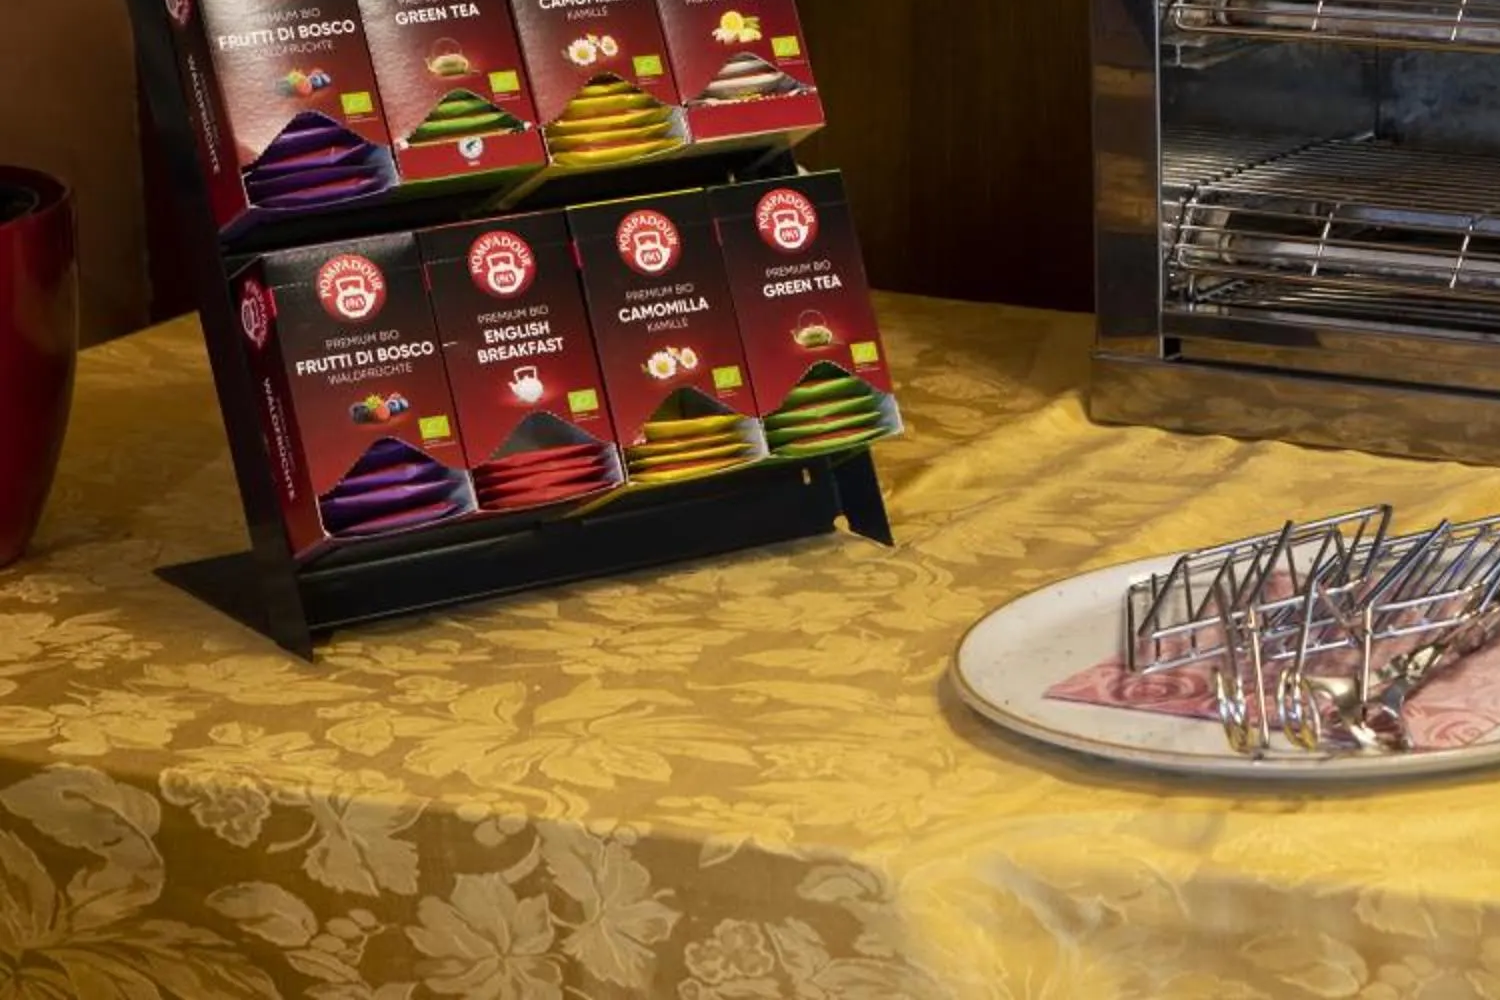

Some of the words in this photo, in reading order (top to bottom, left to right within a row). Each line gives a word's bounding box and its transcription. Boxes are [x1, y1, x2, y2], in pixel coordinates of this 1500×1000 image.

[395, 6, 447, 25] GREEN
[449, 2, 481, 18] TEA
[218, 29, 274, 50] FRUTTI
[277, 25, 295, 41] DI
[297, 19, 355, 39] BOSCO
[471, 235, 532, 274] POMPADOUR
[319, 260, 384, 298] POMPADOUR
[763, 278, 813, 298] GREEN
[813, 273, 843, 290] TEA
[618, 296, 710, 323] CAMOMILLA
[483, 320, 550, 344] ENGLISH
[296, 353, 352, 376] FRUTTI
[355, 349, 374, 366] DI
[376, 341, 434, 362] BOSCO
[477, 336, 564, 365] BREAKFAST
